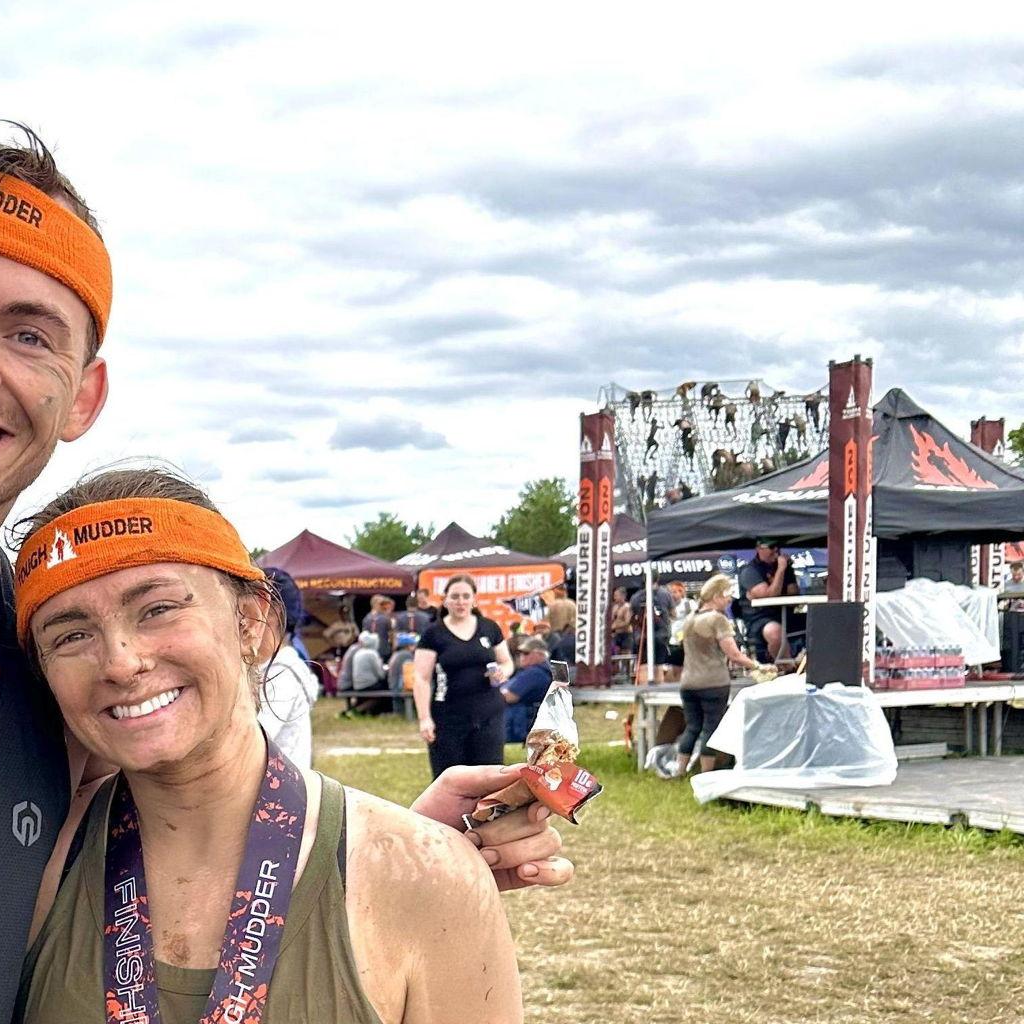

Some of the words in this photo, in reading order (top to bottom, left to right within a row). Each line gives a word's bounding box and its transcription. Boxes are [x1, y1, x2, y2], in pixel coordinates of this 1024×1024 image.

[580, 485, 592, 515] ON
[602, 486, 609, 514] ON
[17, 544, 48, 587] TOUGH
[73, 517, 153, 545] MUDDER
[614, 560, 673, 577] PROTIN
[674, 560, 713, 573] CHIPS
[577, 531, 591, 657] ADVENTURE
[238, 859, 280, 978] MUDDER
